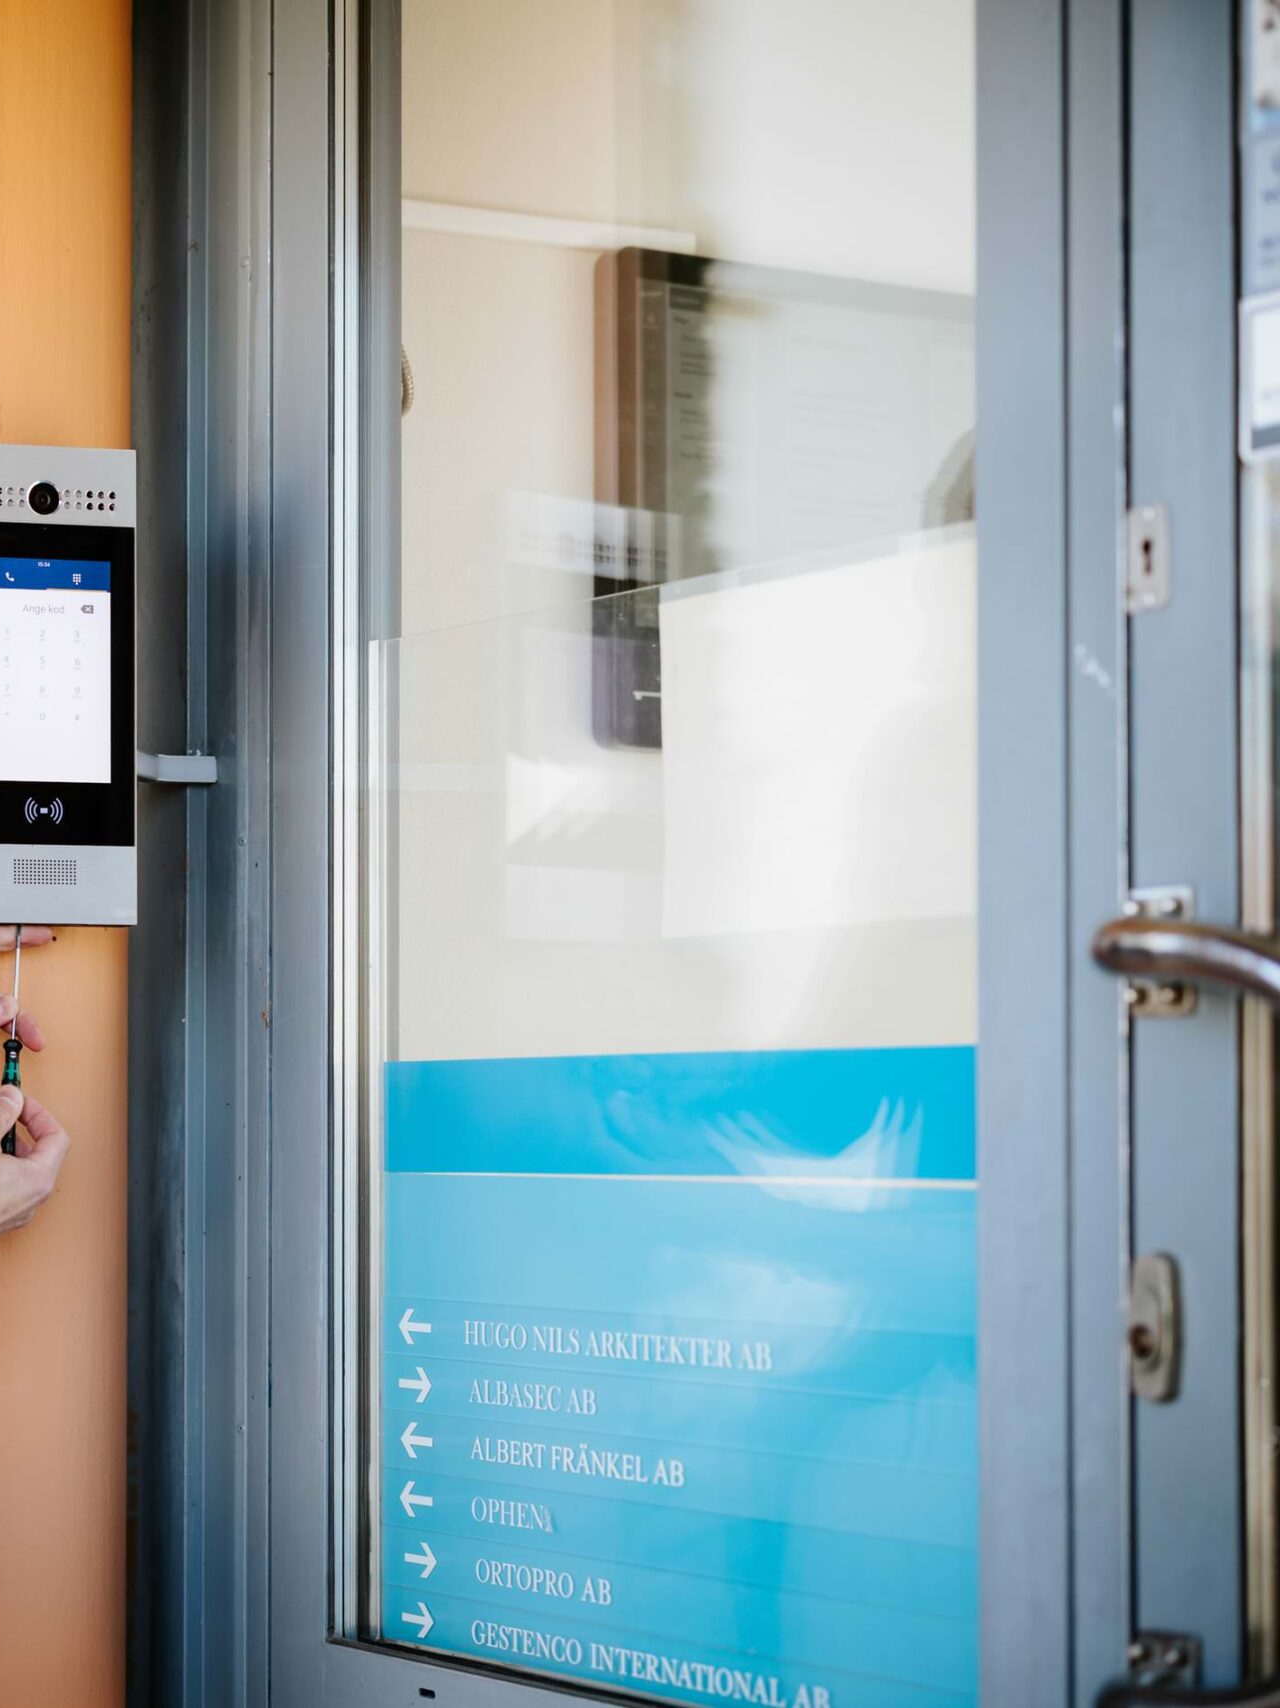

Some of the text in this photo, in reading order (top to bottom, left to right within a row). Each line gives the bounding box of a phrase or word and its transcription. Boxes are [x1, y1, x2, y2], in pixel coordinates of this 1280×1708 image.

[23, 604, 65, 615] Ange kod
[464, 1320, 773, 1371] HUGO NILS ARKITEKTER AB
[469, 1378, 597, 1416] ALBASEC AB
[471, 1436, 685, 1487] ALBERT FRÄNKEL AB
[475, 1558, 612, 1606] ORTOPRO AB
[471, 1620, 831, 1708] GESTENCO INTERNATIONAL AB
